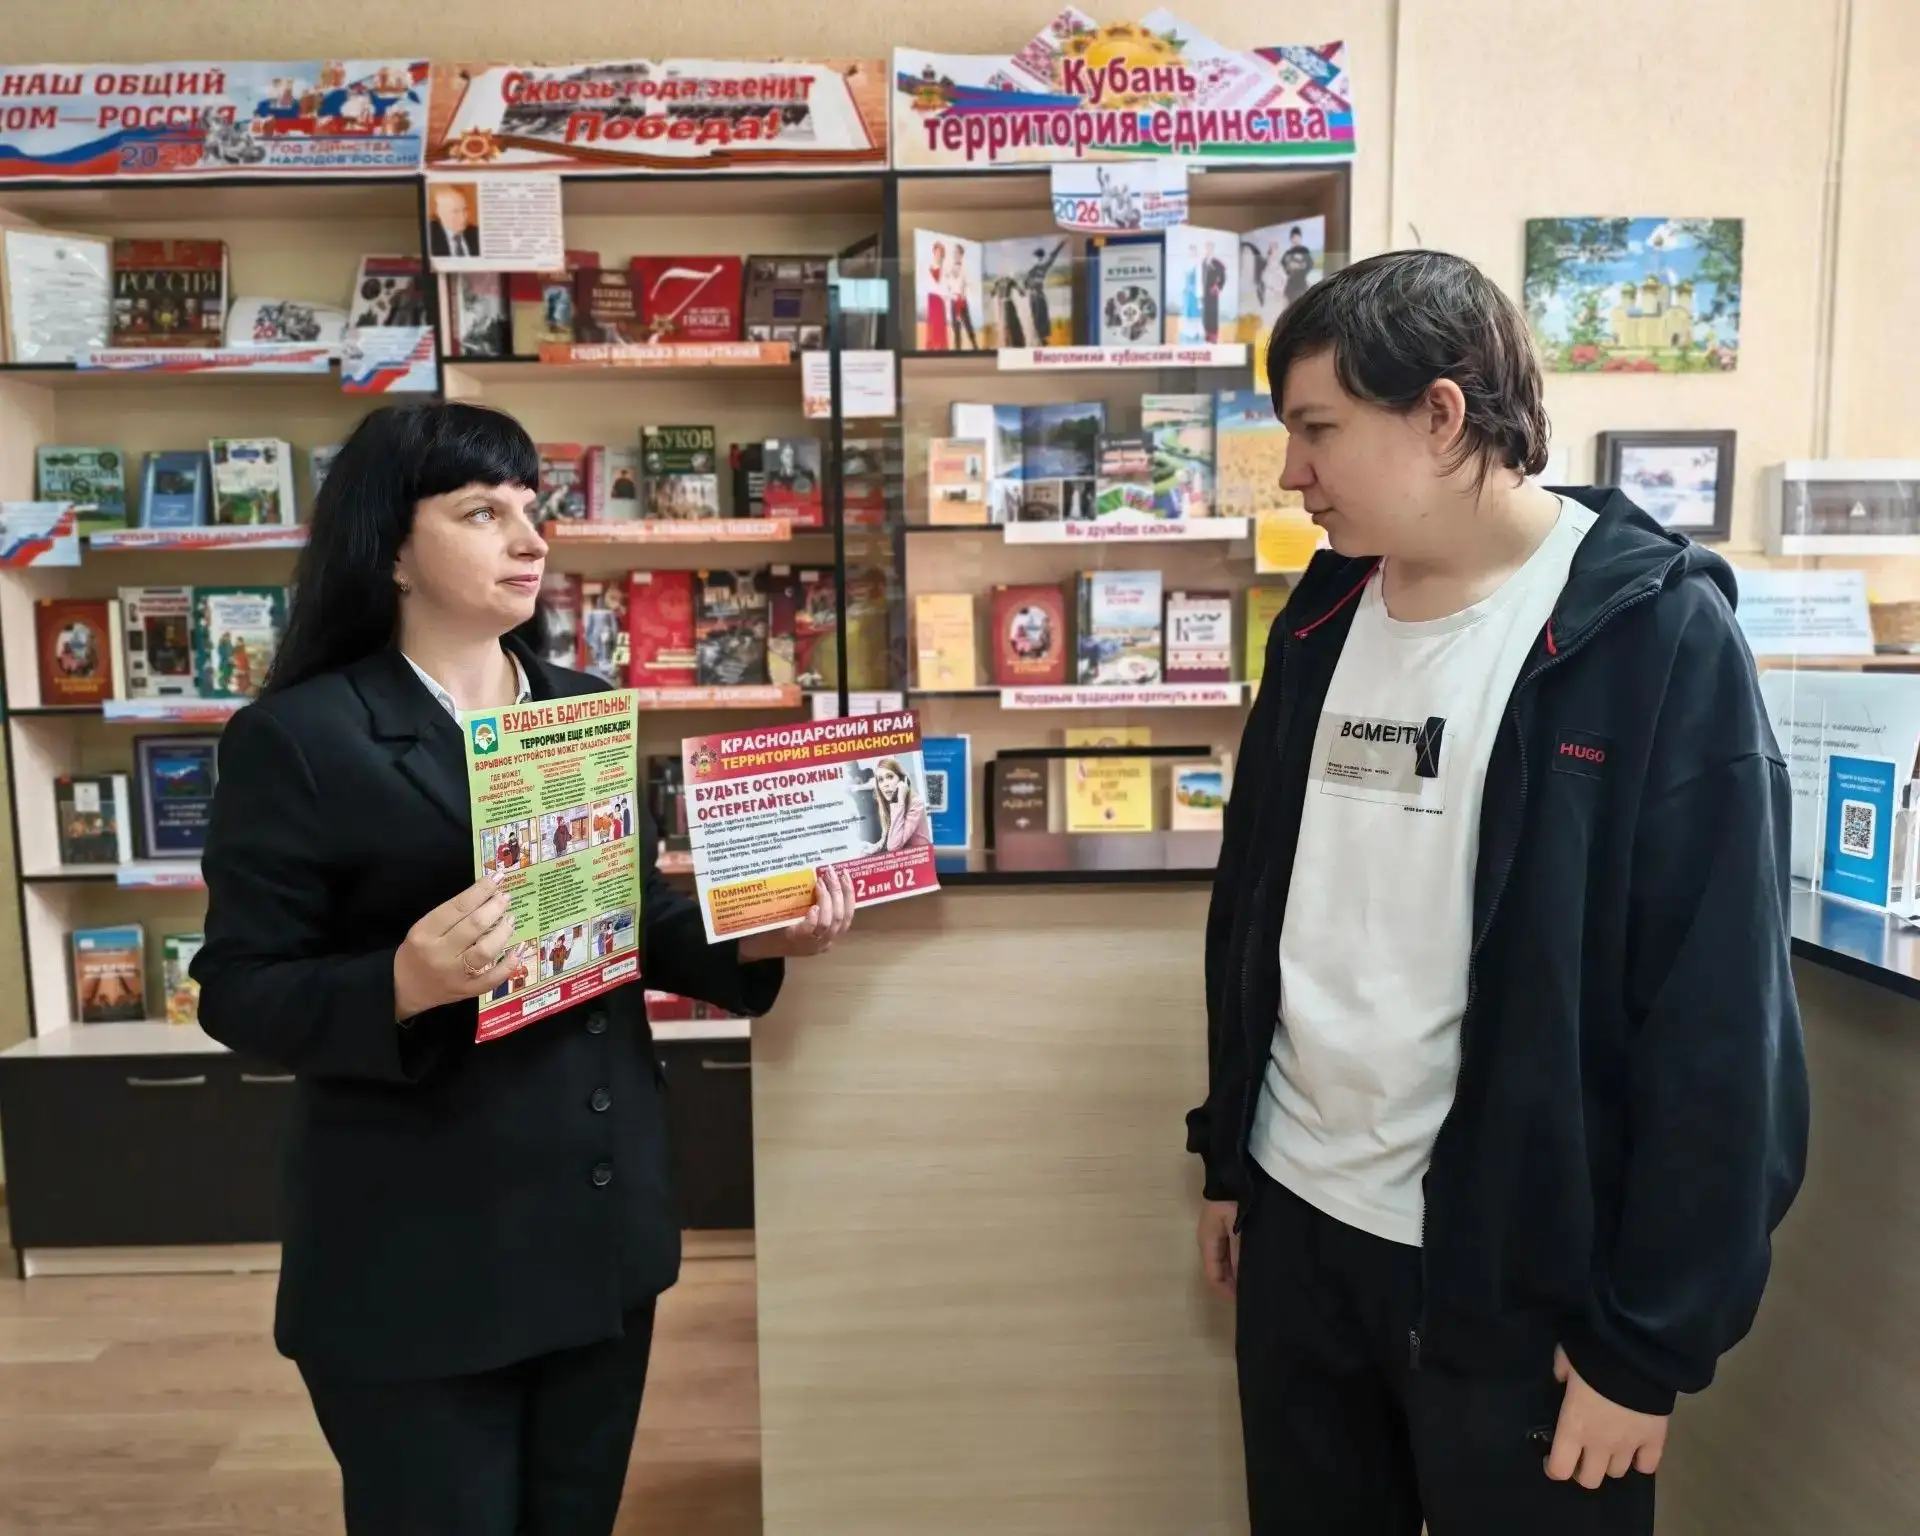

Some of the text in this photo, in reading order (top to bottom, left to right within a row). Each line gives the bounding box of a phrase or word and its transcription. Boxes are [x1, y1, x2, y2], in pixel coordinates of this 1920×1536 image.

[3, 68, 227, 99] НАШ ОБЩИЙ
[501, 71, 816, 105] Сквозь года звенит
[1063, 57, 1197, 104] Кубань
[563, 110, 782, 145] Победа!
[924, 104, 1328, 160] территория единства
[1055, 199, 1100, 222] 2026
[118, 270, 217, 296] РОССИЯ
[502, 695, 632, 732] БУДЬТЕ БДИТЕЛЬНЫ!
[519, 719, 631, 750] ТЕРРОРИЗМ ЕЩЕ НЕ ПОБЕЖДЕН
[720, 712, 914, 754] КРАСНОДАРСКИЙ КРАЙ
[474, 757, 513, 772] ВЗРЫВНОЕ
[513, 747, 556, 765] УСТРОЙСТВО
[556, 743, 579, 756] МОЖЕТ
[579, 737, 611, 751] ОКАЗАТЬСЯ
[720, 732, 915, 771] ТЕРРИТОРИЯ БЕЗОПАСНОСТИ
[1559, 742, 1605, 764] HUGO
[489, 778, 524, 792] НАХОДИТЬСЯ
[490, 769, 522, 782] ГДЕ МОЖЕТ
[695, 766, 844, 802] БУДЬТЕ ОСТОРОЖНЫ!
[696, 789, 816, 821] ОСТЕРЕГАЙТЕСЬ!
[704, 827, 726, 836] обычно
[710, 864, 750, 876] Остерегайтесь
[712, 879, 767, 899] Помните!
[868, 882, 891, 895] или
